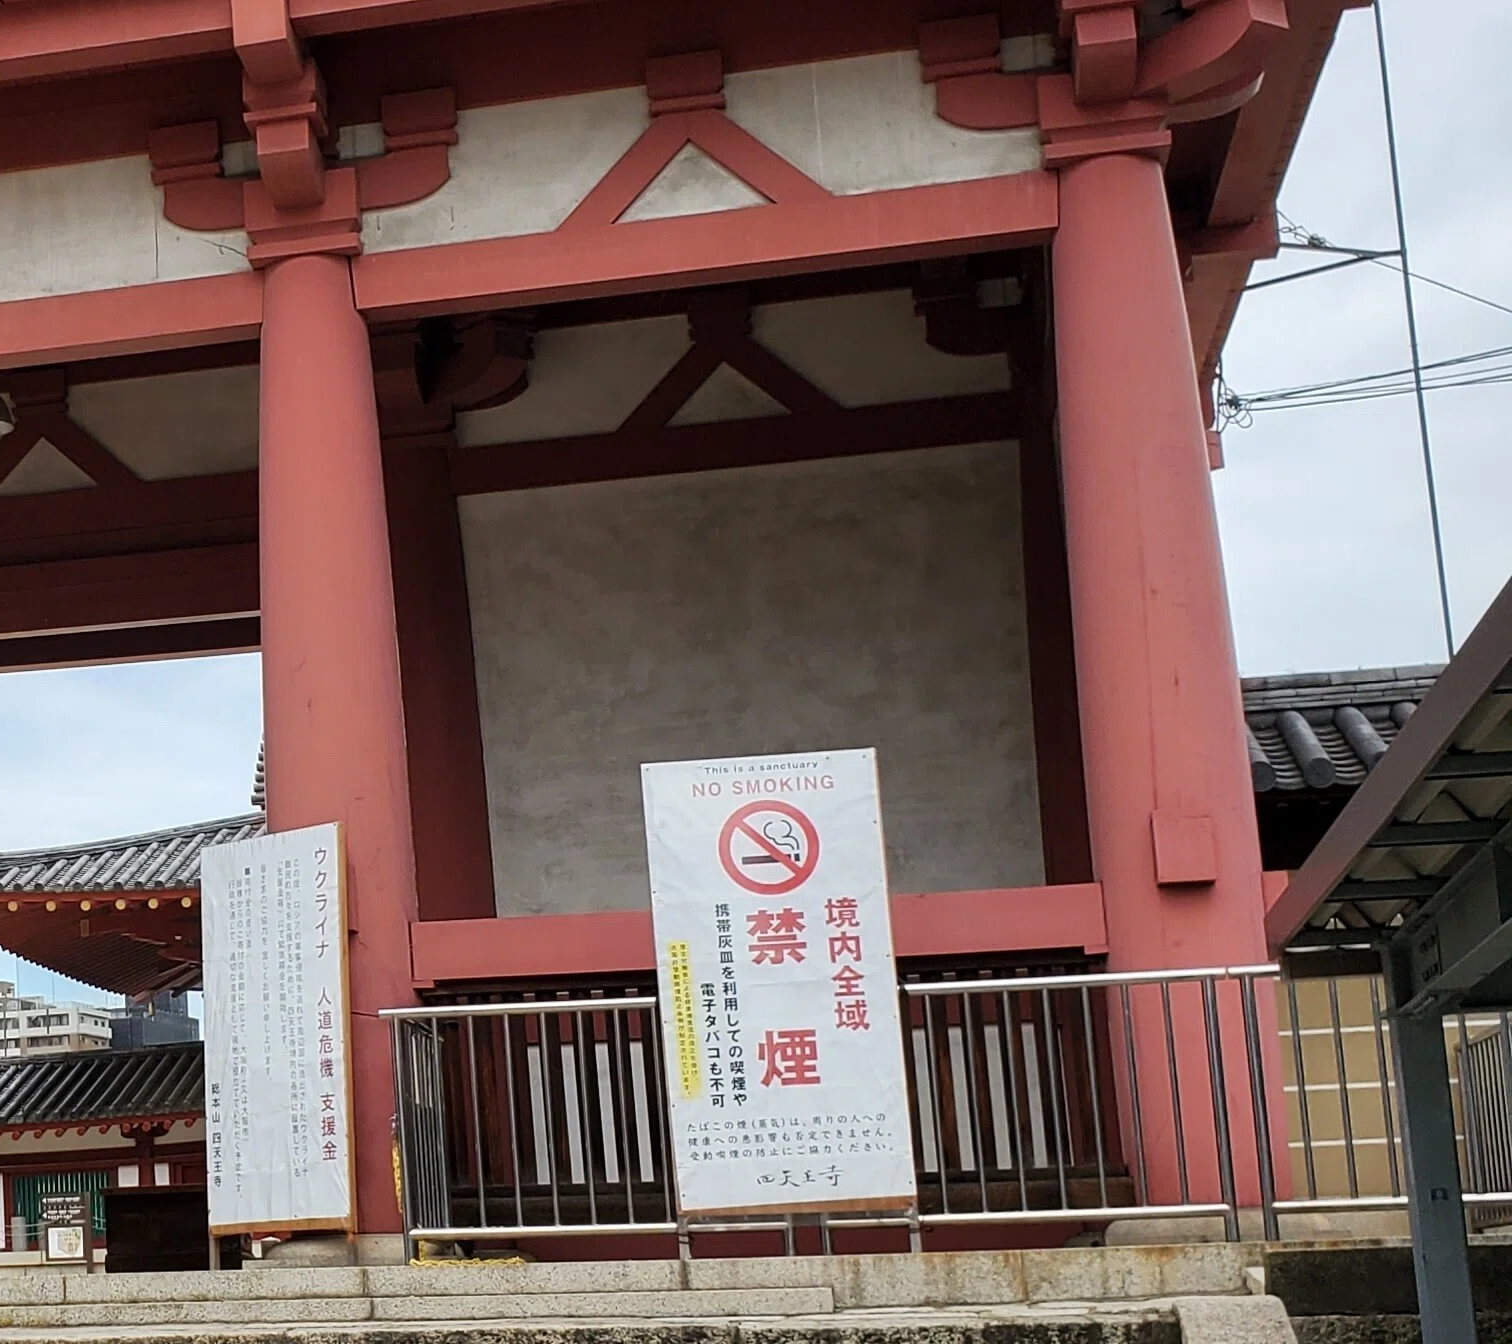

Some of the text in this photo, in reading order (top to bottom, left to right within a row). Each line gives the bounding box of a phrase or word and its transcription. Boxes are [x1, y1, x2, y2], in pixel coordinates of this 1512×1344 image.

[692, 774, 834, 798] NO SMOKING
[704, 760, 818, 775] This is a sanctuary
[314, 847, 338, 1161] ウクライナ 人道危機 支援金
[714, 903, 748, 1106] 携帯灰皿を利用しての喫煙や
[745, 907, 821, 1088] 禁煙
[824, 897, 870, 1031] 境内全域
[700, 982, 726, 1109] 電子タバコも不可
[211, 1082, 222, 1187] 総本山 四天王寺
[688, 1128, 892, 1147] 健康への悪影響も否定できません。
[689, 1142, 894, 1161] 受動喫煙の防止にご協力ください。
[756, 1164, 844, 1187] 四天王寺
